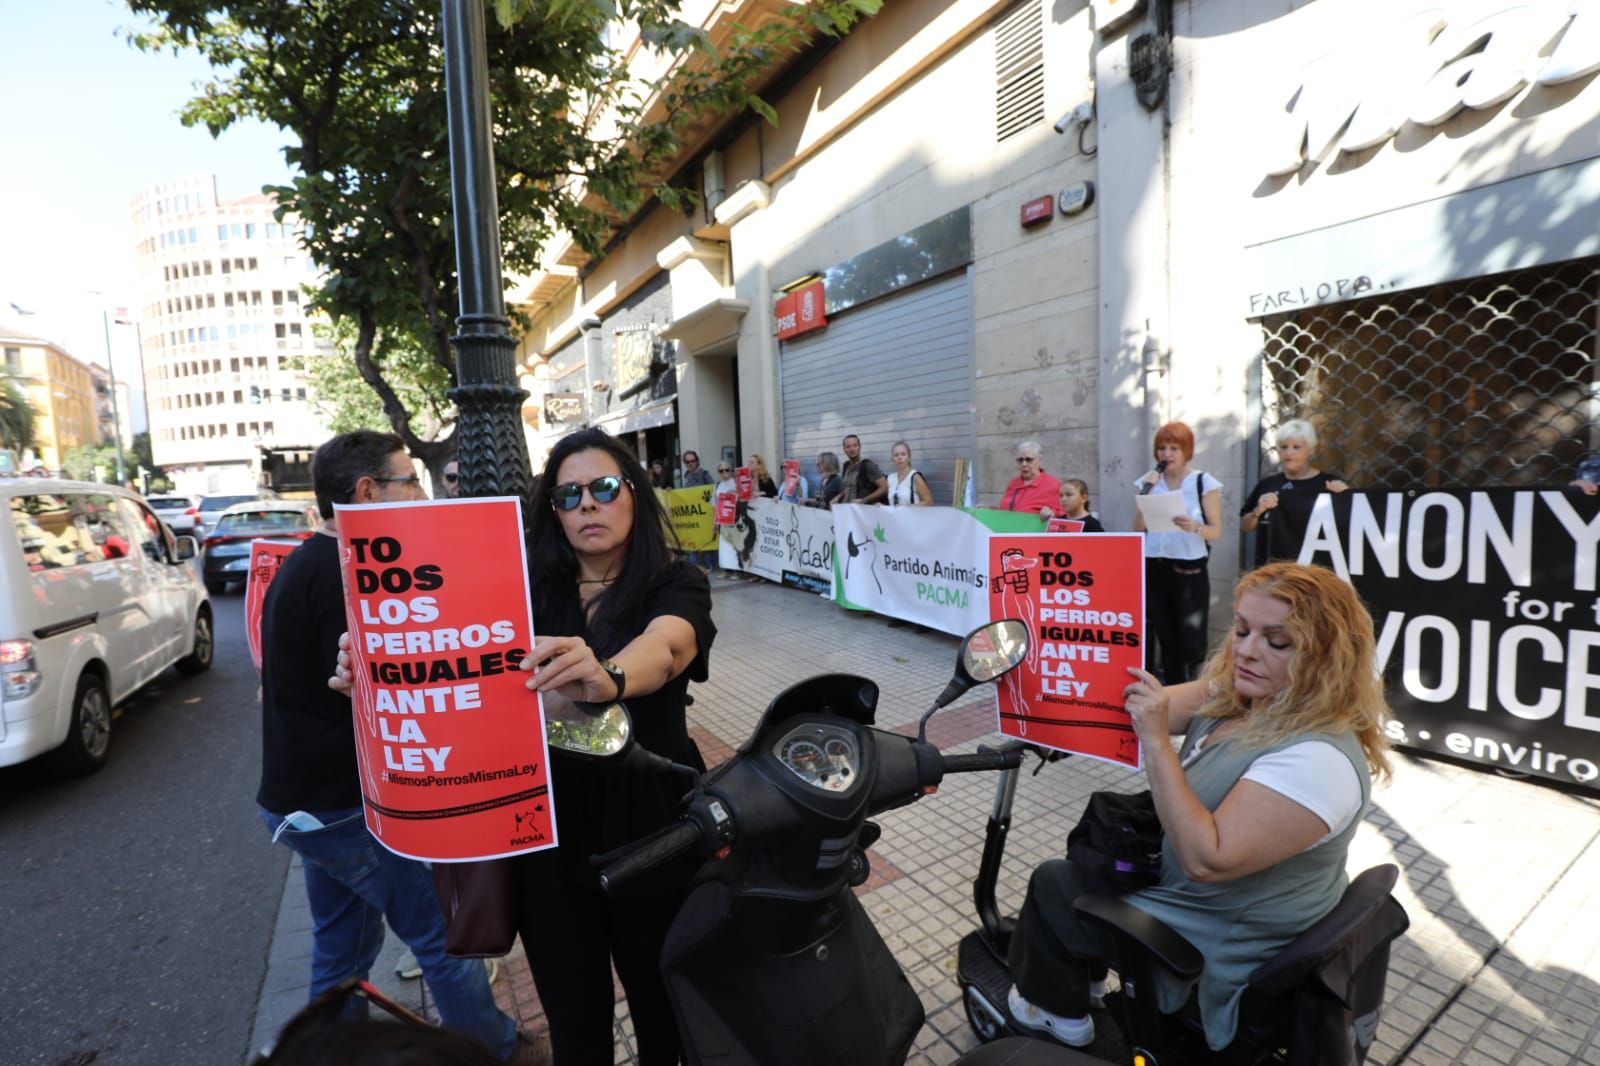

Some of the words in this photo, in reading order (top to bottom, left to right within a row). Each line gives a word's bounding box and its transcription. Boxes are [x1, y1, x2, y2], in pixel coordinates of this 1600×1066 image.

[777, 312, 796, 332] PSOE
[670, 503, 707, 517] NIMAL
[350, 537, 402, 563] TO
[1039, 552, 1072, 567] TO
[884, 553, 930, 577] Partido
[356, 564, 444, 594] DOS
[1040, 570, 1094, 587] DOS
[915, 581, 970, 610] PACMA
[1040, 589, 1090, 605] LOS
[1503, 591, 1574, 622] for
[360, 597, 440, 625] LOS
[1040, 607, 1133, 628] PERROS
[365, 620, 516, 655] PERROS
[1041, 626, 1139, 648] IGUALES
[1040, 643, 1110, 664] ANTE
[370, 648, 527, 685] IGUALES
[1041, 662, 1074, 679] LA
[375, 683, 482, 714] ANTE
[1041, 680, 1089, 698] LEY
[379, 718, 427, 743] LA
[383, 746, 452, 772] LEY
[1445, 732, 1599, 781] enviro
[381, 763, 538, 787] #MismosPerrosMismaLey
[510, 833, 545, 847] PACMA
